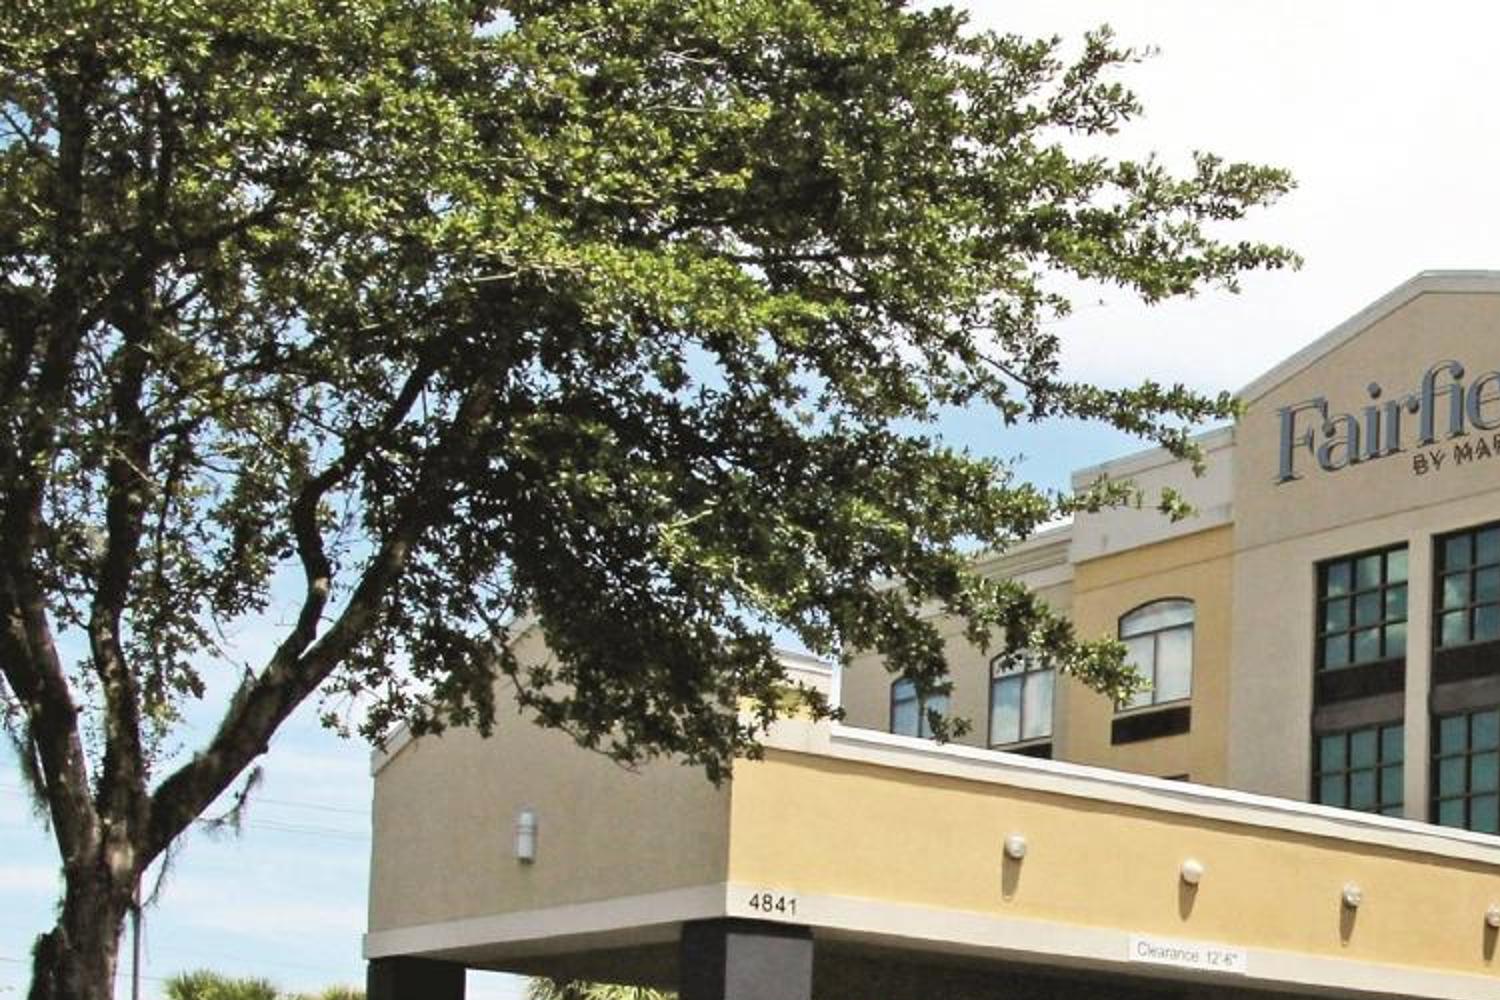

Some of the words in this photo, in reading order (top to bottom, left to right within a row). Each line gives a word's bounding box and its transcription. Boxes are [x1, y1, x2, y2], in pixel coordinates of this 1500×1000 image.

[1413, 449, 1446, 476] BY
[749, 893, 798, 916] 4841
[1136, 940, 1199, 963] Clearance
